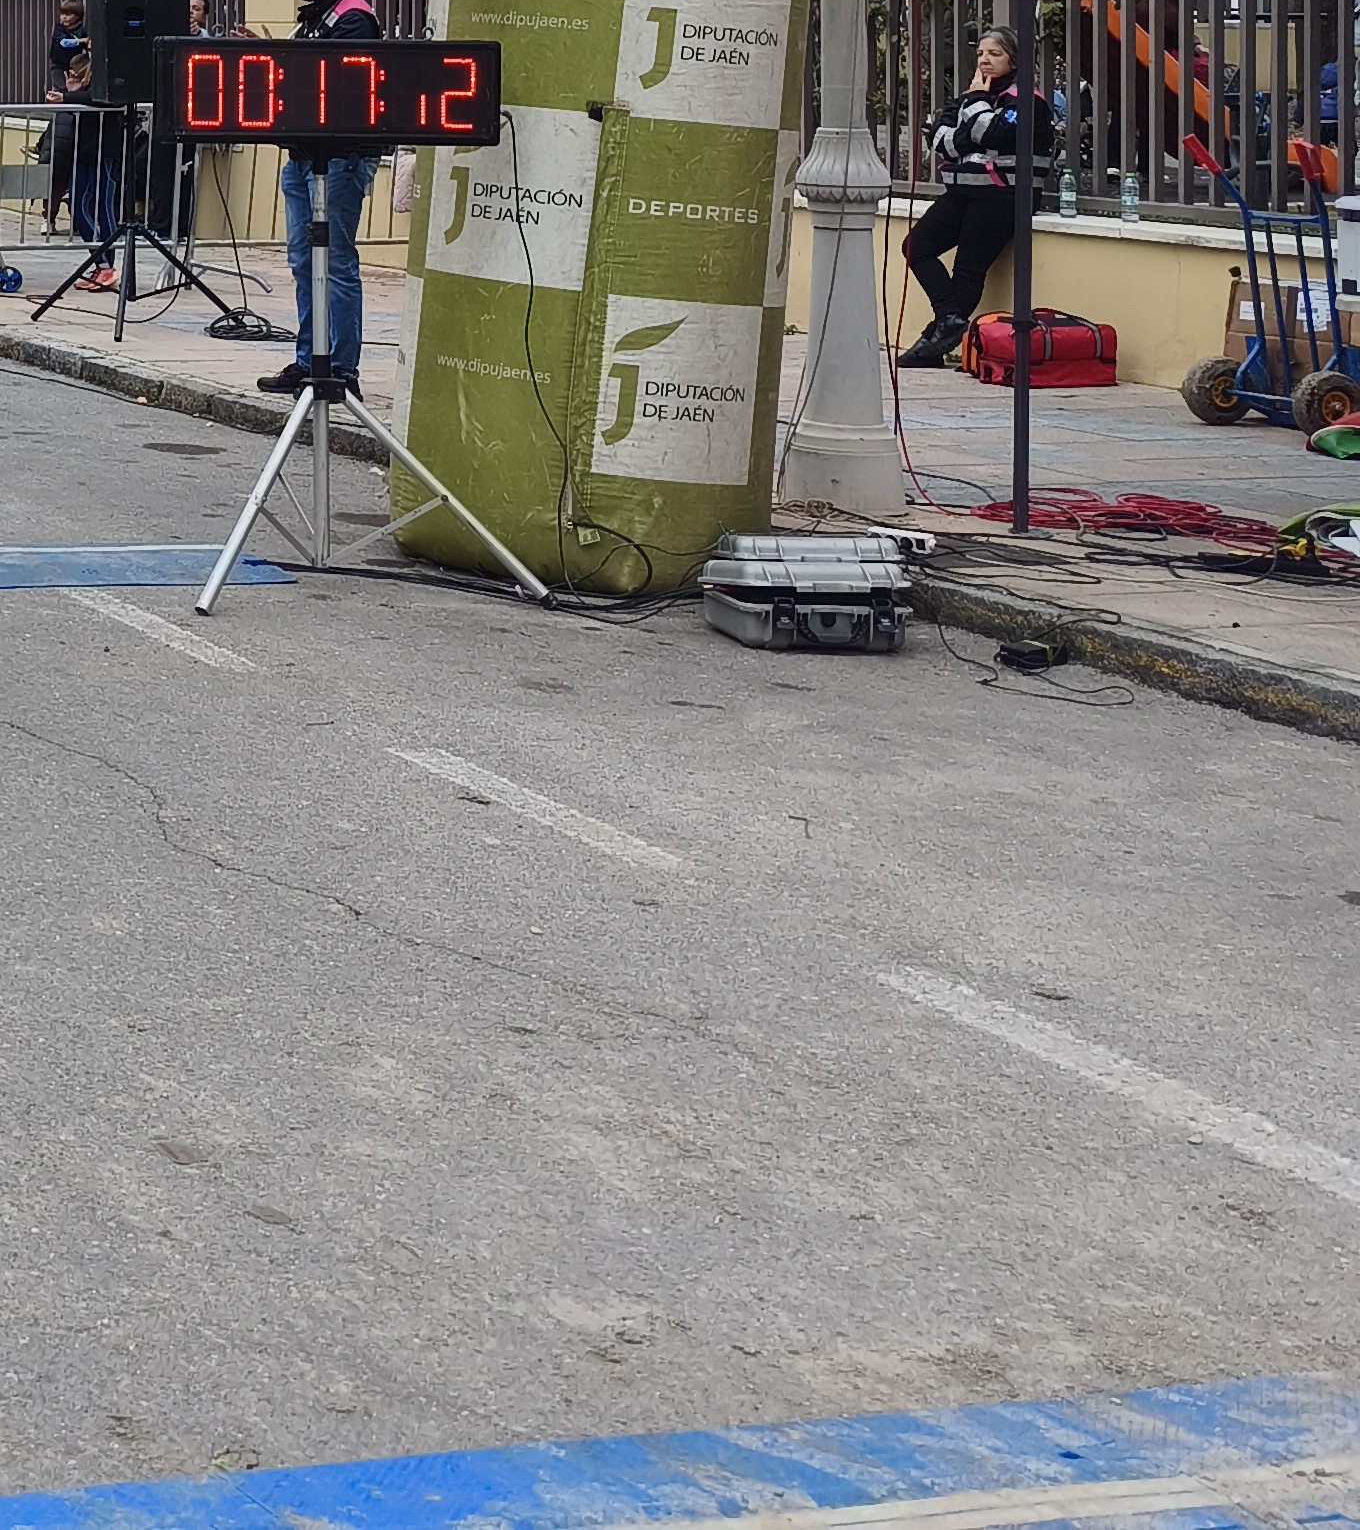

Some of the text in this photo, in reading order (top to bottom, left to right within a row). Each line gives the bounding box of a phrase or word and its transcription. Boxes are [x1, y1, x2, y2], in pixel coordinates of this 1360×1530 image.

[472, 11, 588, 29] www.dipujaen.es
[683, 24, 777, 46] DIPUTACIÓN
[681, 46, 749, 65] DE JAÉN
[473, 182, 582, 207] DIPUTACIÓN
[471, 204, 541, 226] DE JAÉN
[629, 199, 758, 223] DEPORTES
[645, 382, 744, 401] DIPUTACIÓN
[643, 403, 714, 422] DE JAÉN
